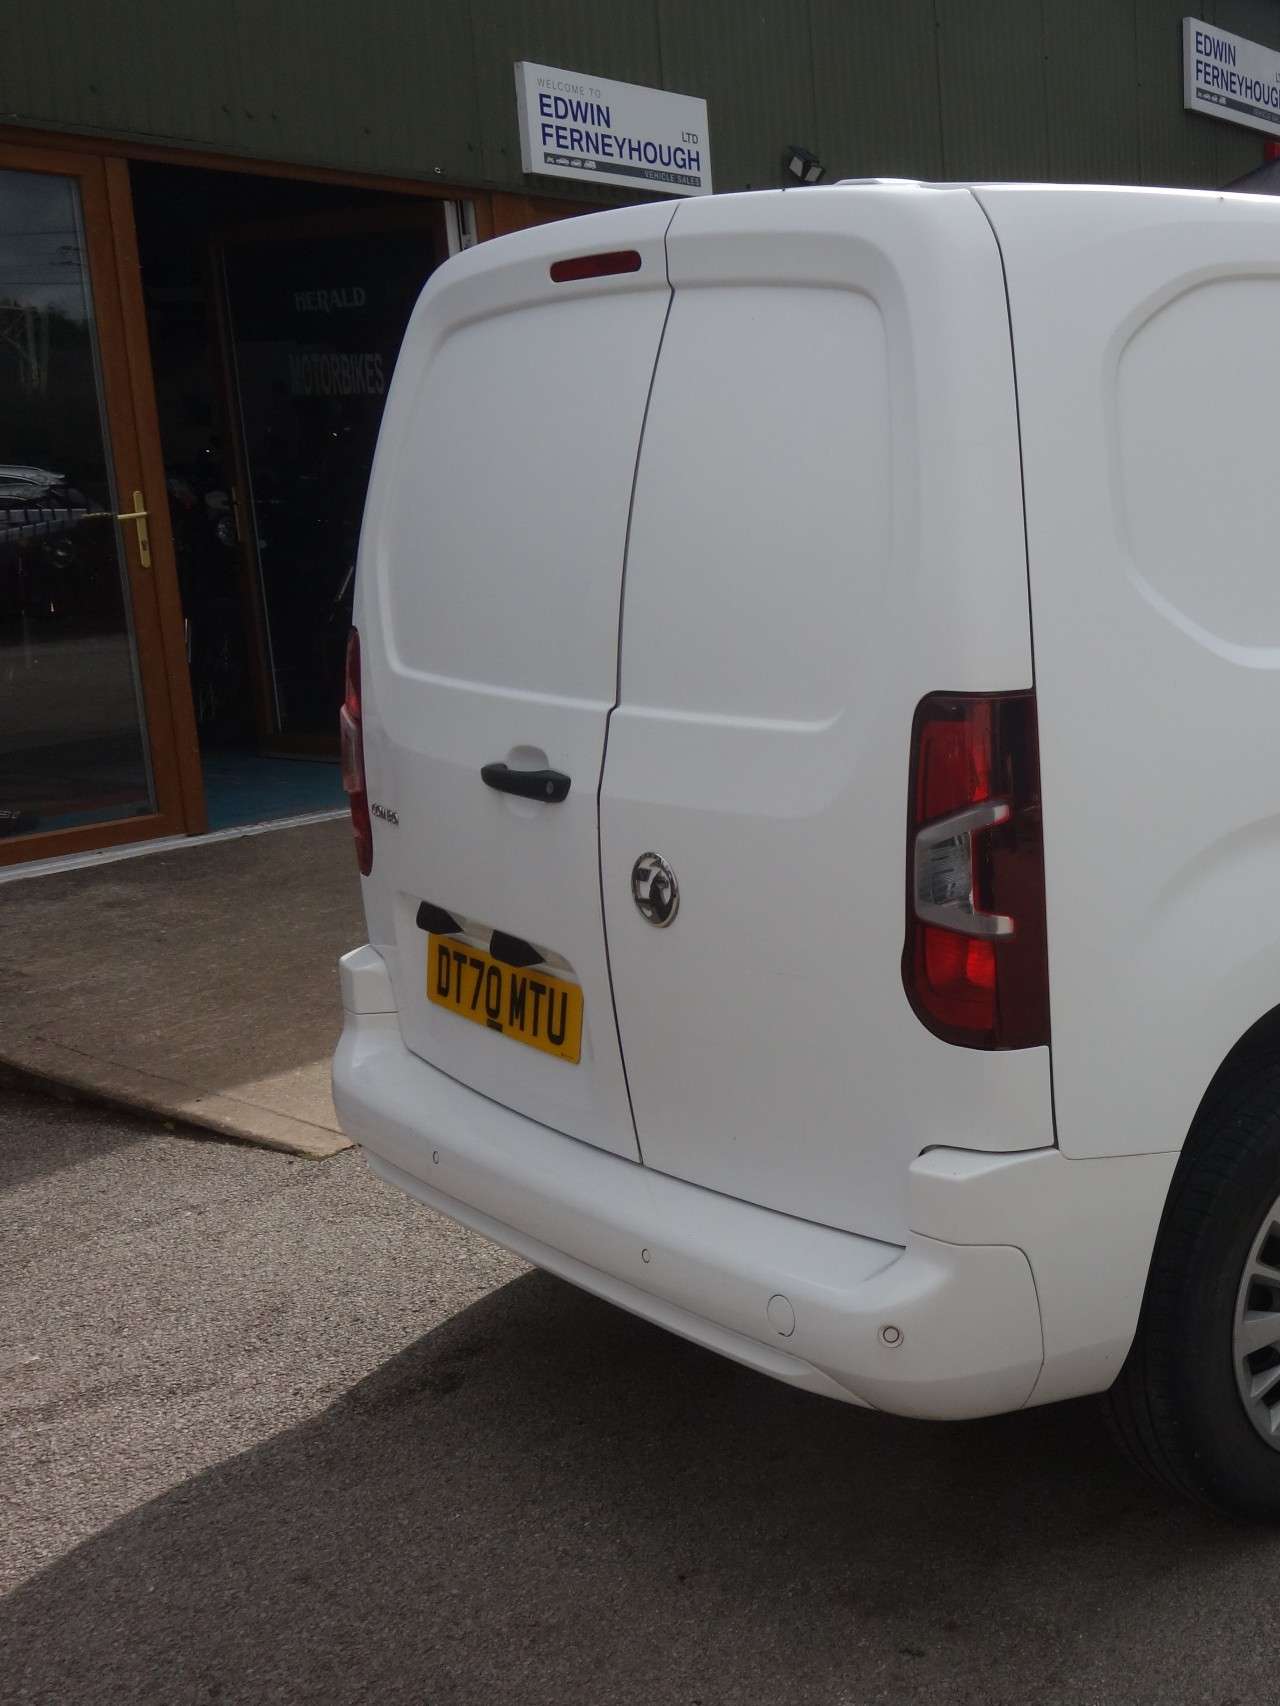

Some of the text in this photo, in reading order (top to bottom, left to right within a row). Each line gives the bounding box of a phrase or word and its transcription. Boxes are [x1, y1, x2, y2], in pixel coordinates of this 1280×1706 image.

[1196, 31, 1236, 66] EDWIN
[537, 78, 601, 98] WELCOME TO
[539, 93, 611, 128] EDWIN
[541, 123, 700, 172] FERNEYHOUGH
[682, 131, 698, 144] LTD
[645, 170, 700, 186] VEHICLE SALES
[293, 287, 366, 312] HERALD
[288, 352, 384, 394] MOTORBIKES
[436, 944, 568, 1045] DT70 MTU
